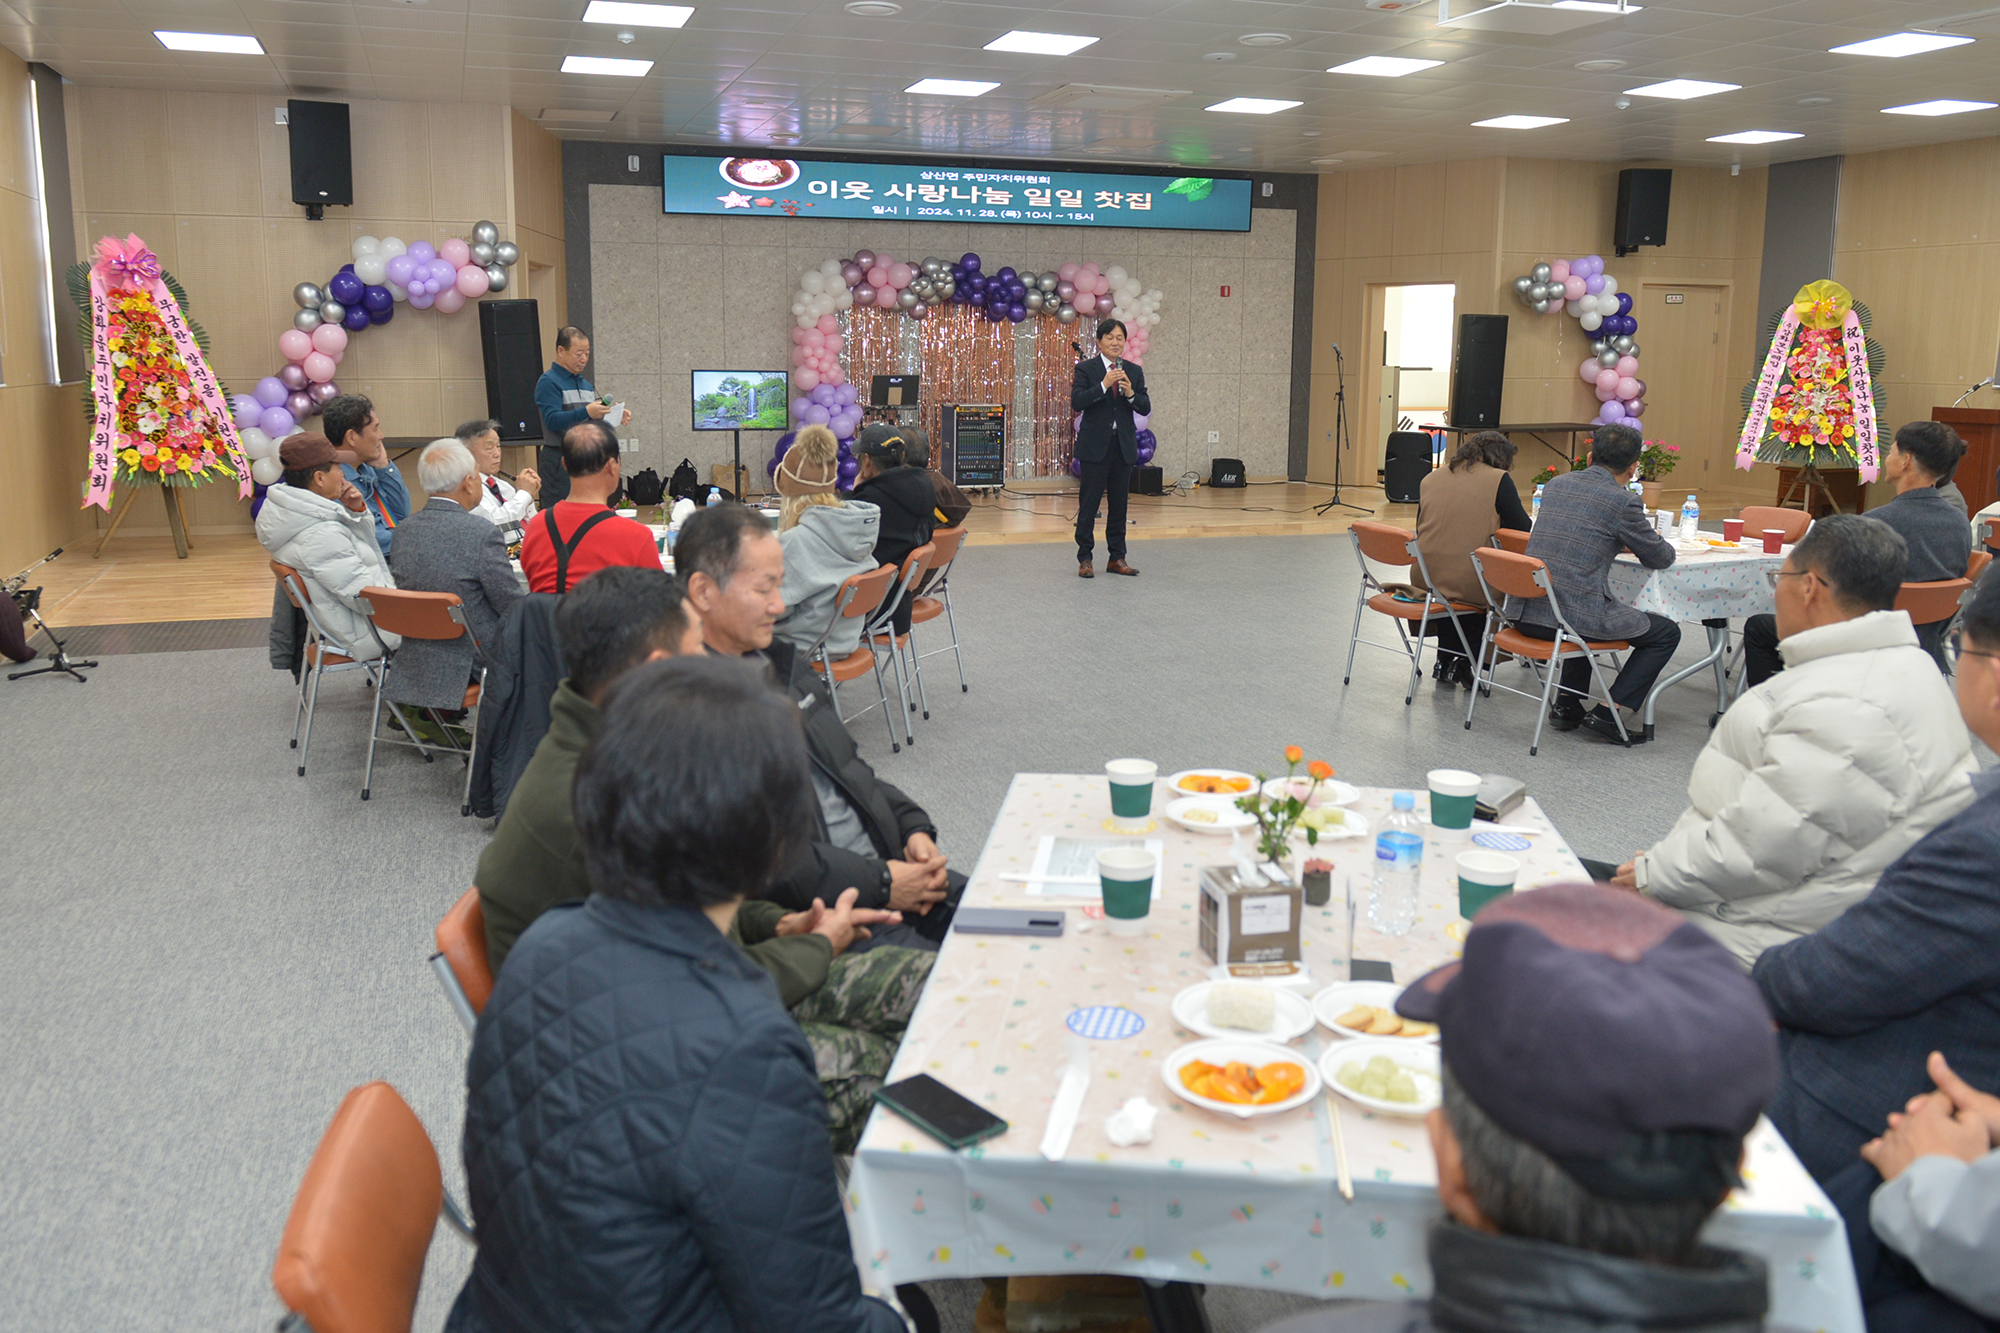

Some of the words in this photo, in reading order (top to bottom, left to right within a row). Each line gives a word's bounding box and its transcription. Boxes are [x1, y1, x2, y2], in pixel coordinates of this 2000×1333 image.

[920, 171, 959, 181] 삼산면
[962, 173, 1051, 185] 주민자치위원회
[807, 180, 874, 201] 이웃
[883, 182, 1014, 205] 사랑나눔
[1023, 188, 1083, 208] 일일
[1094, 190, 1152, 210] 찻집
[871, 205, 898, 215] 일시
[917, 207, 954, 216] 2024.
[1025, 211, 1052, 220] 10시
[1067, 212, 1094, 221] 15시
[1846, 326, 1860, 340] 祝
[159, 298, 188, 344] 무궁한
[185, 352, 216, 398] 발전을
[212, 406, 250, 483] 기원합니다
